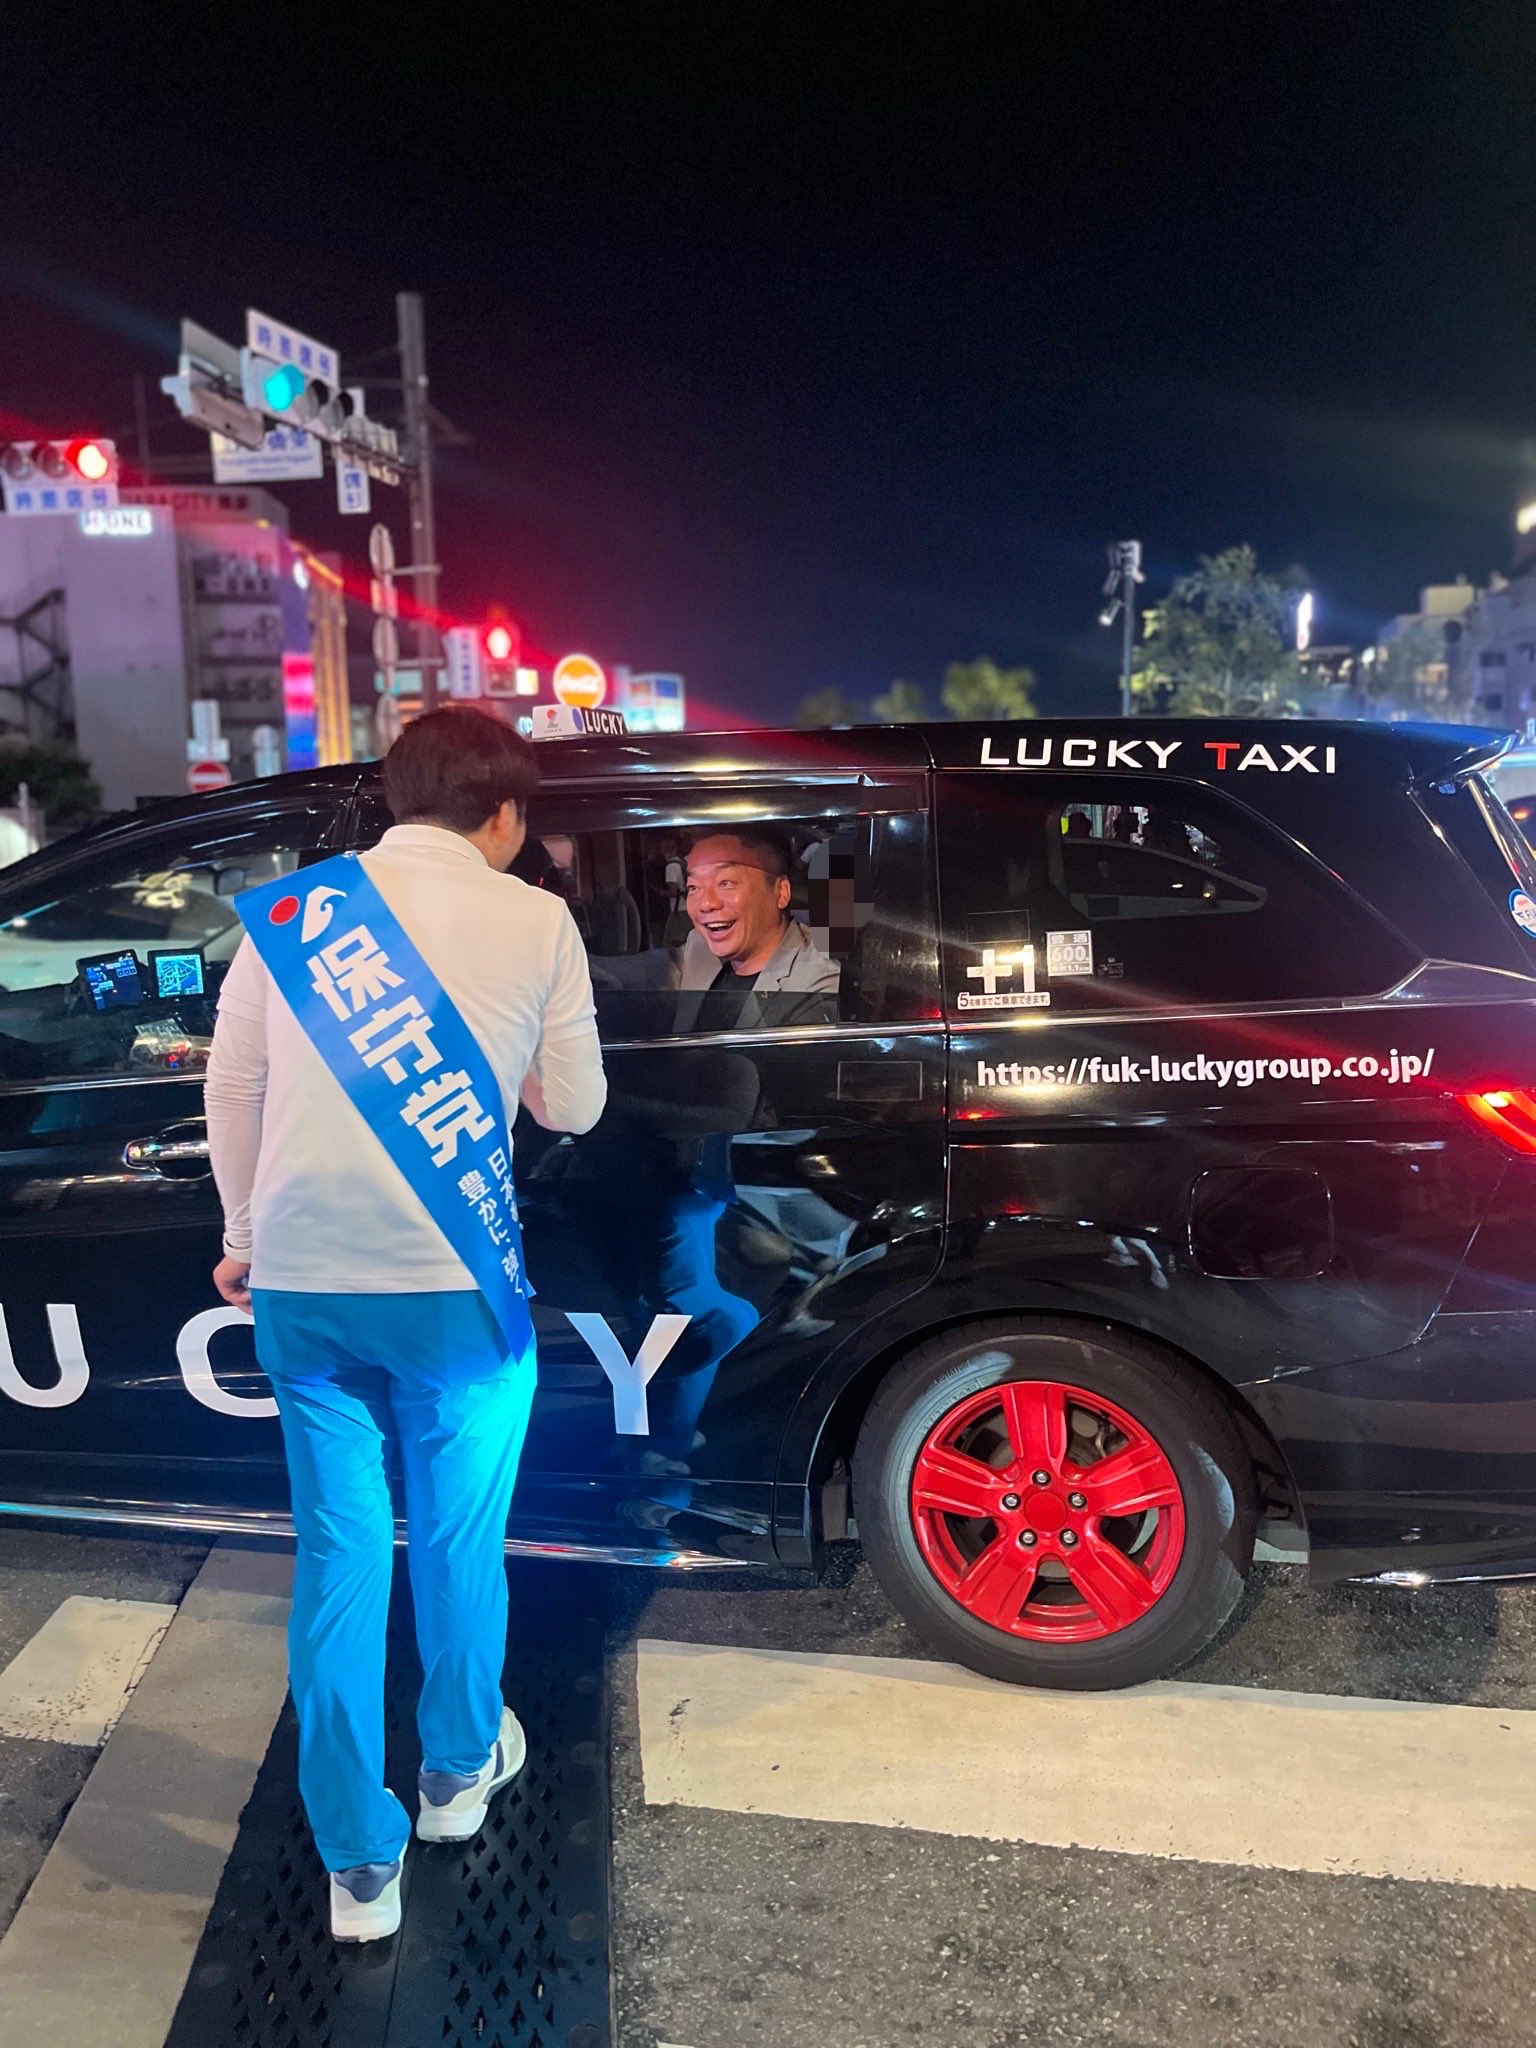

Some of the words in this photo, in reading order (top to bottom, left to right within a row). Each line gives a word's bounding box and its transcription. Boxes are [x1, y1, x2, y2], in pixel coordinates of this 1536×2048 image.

[584, 709, 626, 735] LUCKY
[980, 737, 1182, 769] LUCKY
[1204, 742, 1336, 775] TAXI
[305, 923, 497, 1169] 保守党
[977, 1049, 1434, 1088] https://fuk-luckygroup.co.jp/
